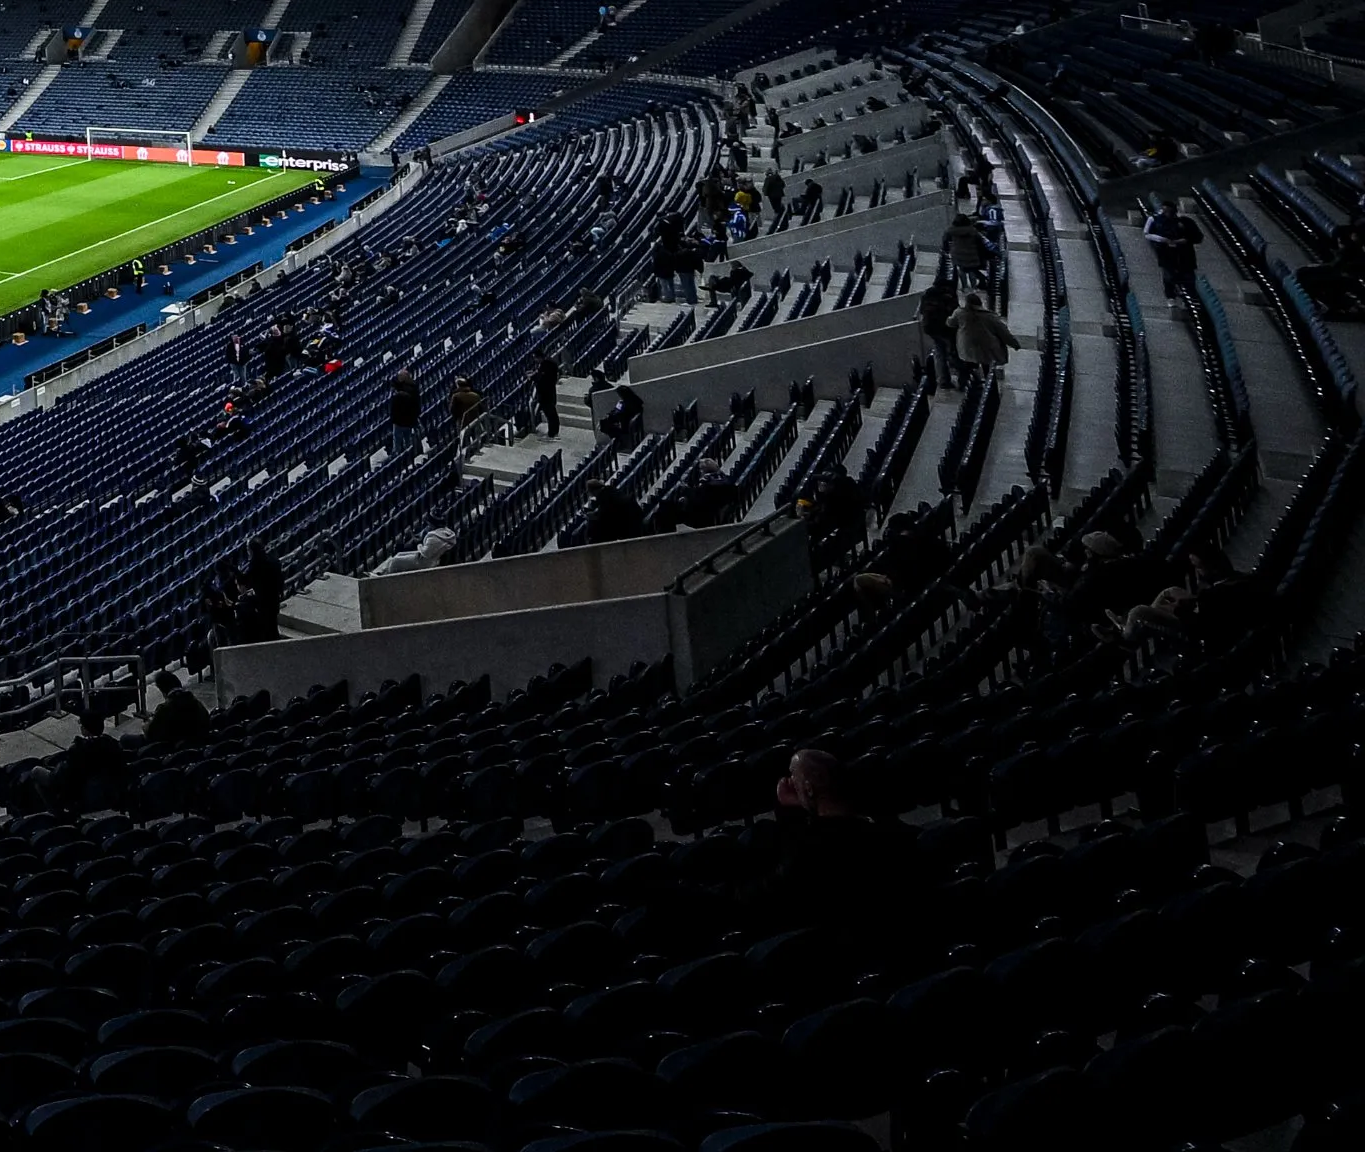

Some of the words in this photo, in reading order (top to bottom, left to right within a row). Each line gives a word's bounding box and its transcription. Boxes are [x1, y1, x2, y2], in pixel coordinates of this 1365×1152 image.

[25, 142, 66, 154] STRAUSS
[77, 145, 119, 156] STRAUSS
[265, 156, 349, 171] enterprise
